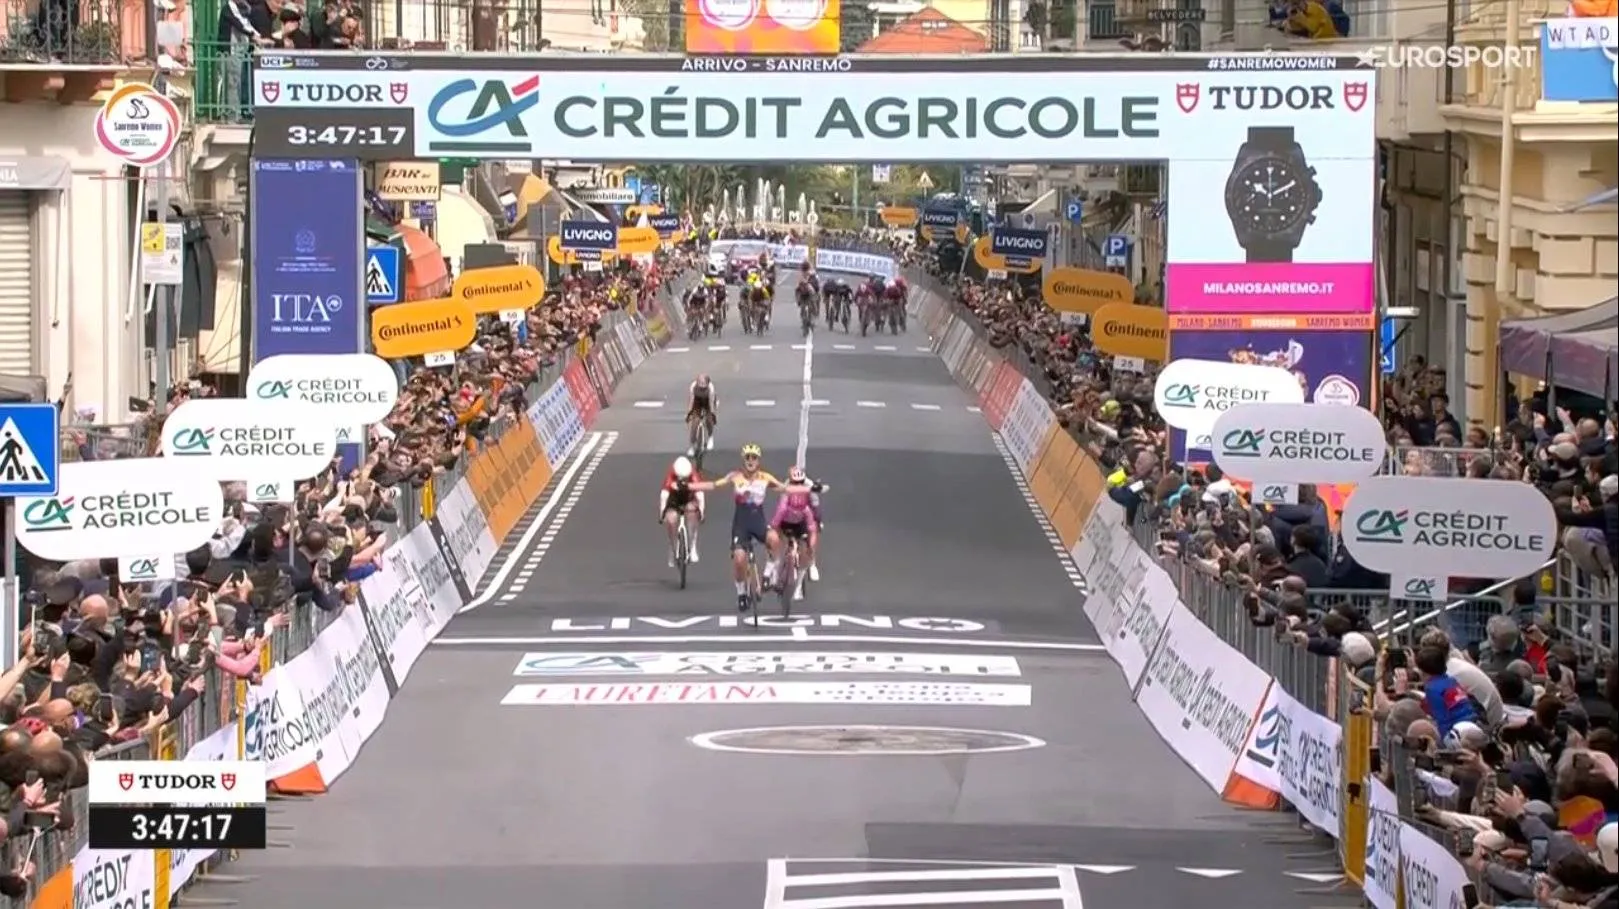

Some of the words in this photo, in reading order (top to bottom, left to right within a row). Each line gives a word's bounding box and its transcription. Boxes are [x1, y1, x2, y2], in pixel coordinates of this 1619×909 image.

[682, 59, 746, 71] ARRIVO
[766, 59, 852, 71] SANREMO
[1207, 57, 1337, 70] #SANREMOWOMEN
[287, 84, 383, 102] TUDOR
[1209, 85, 1334, 110] TUDOR
[553, 86, 802, 139] CRÉDIT
[815, 96, 1160, 139] AGRICOLE
[288, 125, 406, 145] 3:47:17
[384, 168, 421, 178] BAR
[1068, 204, 1078, 218] P
[564, 229, 613, 241] LIVIGNO
[995, 235, 1044, 250] LIVIGNO
[1111, 238, 1124, 254] P
[462, 281, 523, 299] Continental
[1052, 280, 1114, 300] Continental
[1203, 281, 1335, 295] MILANOSANREMO.IT
[271, 294, 331, 322] ITA
[378, 317, 451, 341] Continental
[1103, 320, 1166, 340] Continent
[297, 377, 363, 390] CRÉDIT
[1204, 386, 1270, 401] CRÉDIT
[219, 426, 296, 441] CRÉDIT
[1269, 429, 1346, 445] CRÉDIT
[219, 442, 326, 456] AGRICOLE
[1269, 446, 1374, 462] AGRICOLE
[81, 490, 173, 513] CRÉDIT
[83, 506, 210, 529] AGRICOLE
[1414, 510, 1509, 531] CRÉDIT
[1413, 530, 1544, 551] AGRICOLE
[551, 615, 985, 633] LIVIGNO
[534, 684, 778, 702] LAURETANA
